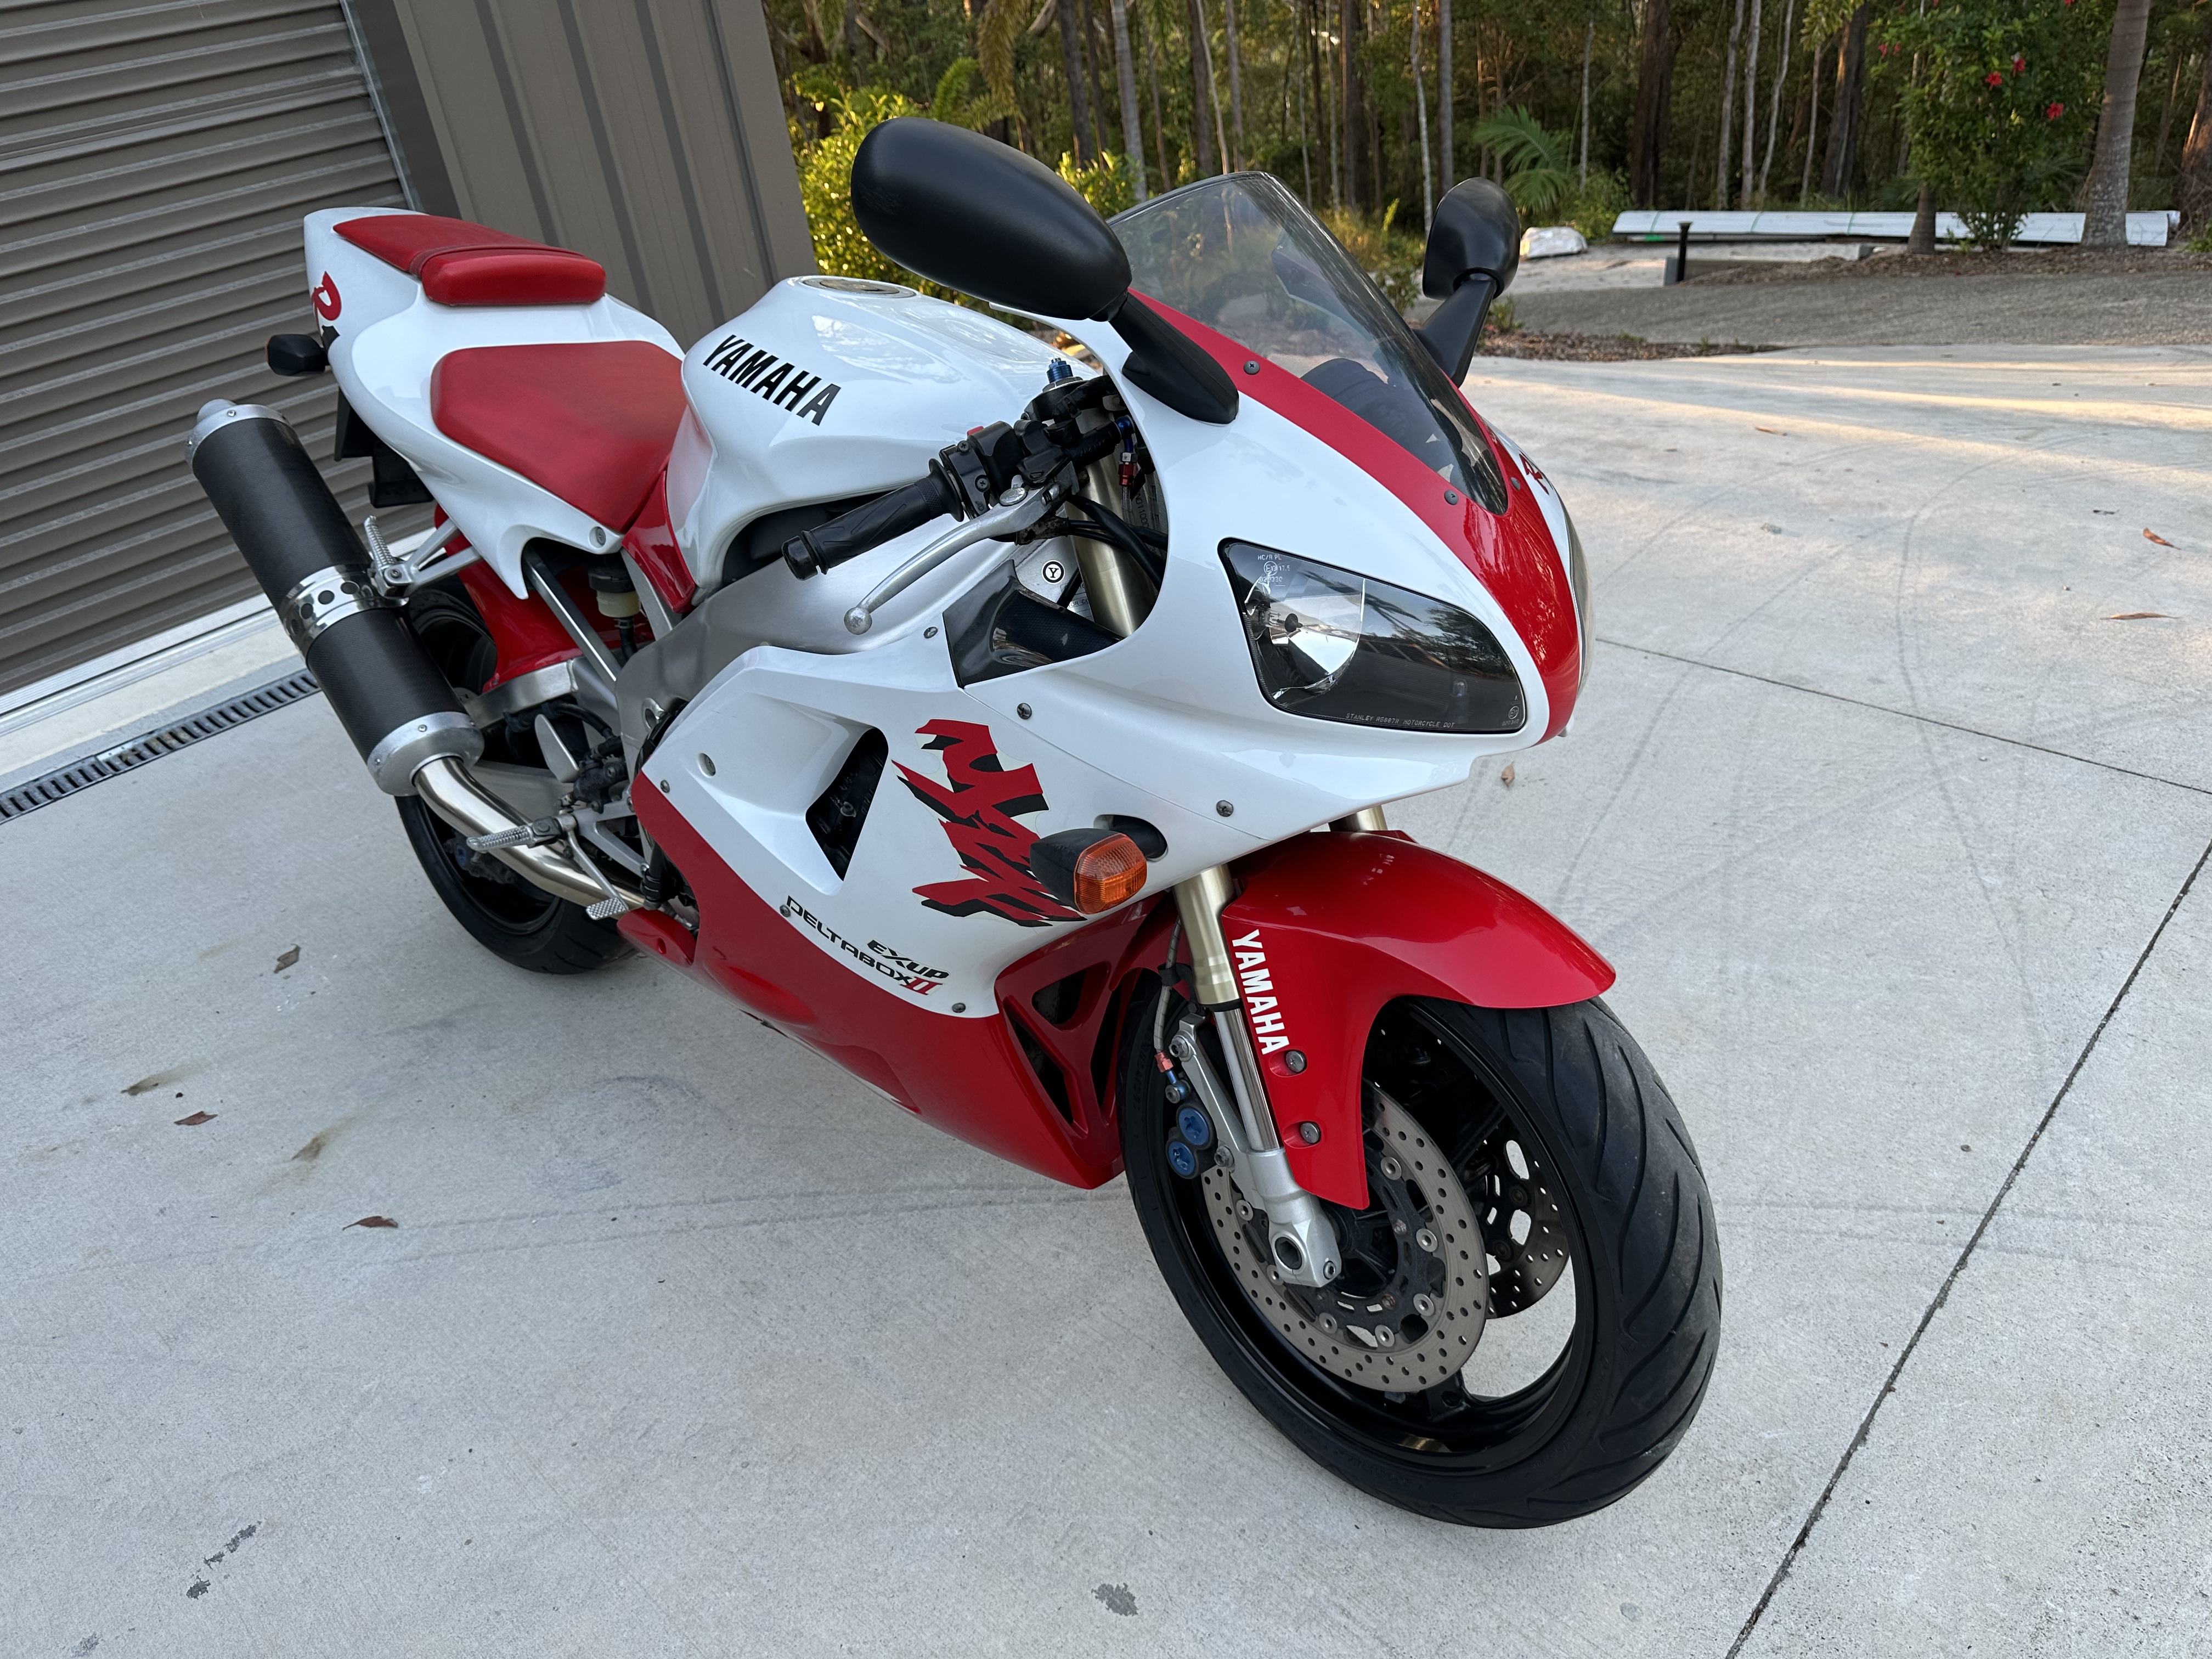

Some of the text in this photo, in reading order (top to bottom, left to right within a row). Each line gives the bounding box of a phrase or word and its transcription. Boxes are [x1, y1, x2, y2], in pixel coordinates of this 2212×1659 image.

[702, 334, 842, 426] YAMAHA
[1346, 713, 1374, 721] STANLEY
[1403, 719, 1441, 727] MOTORCYCLE
[867, 939, 950, 979] EXUP
[1232, 929, 1290, 1055] YAMAHA
